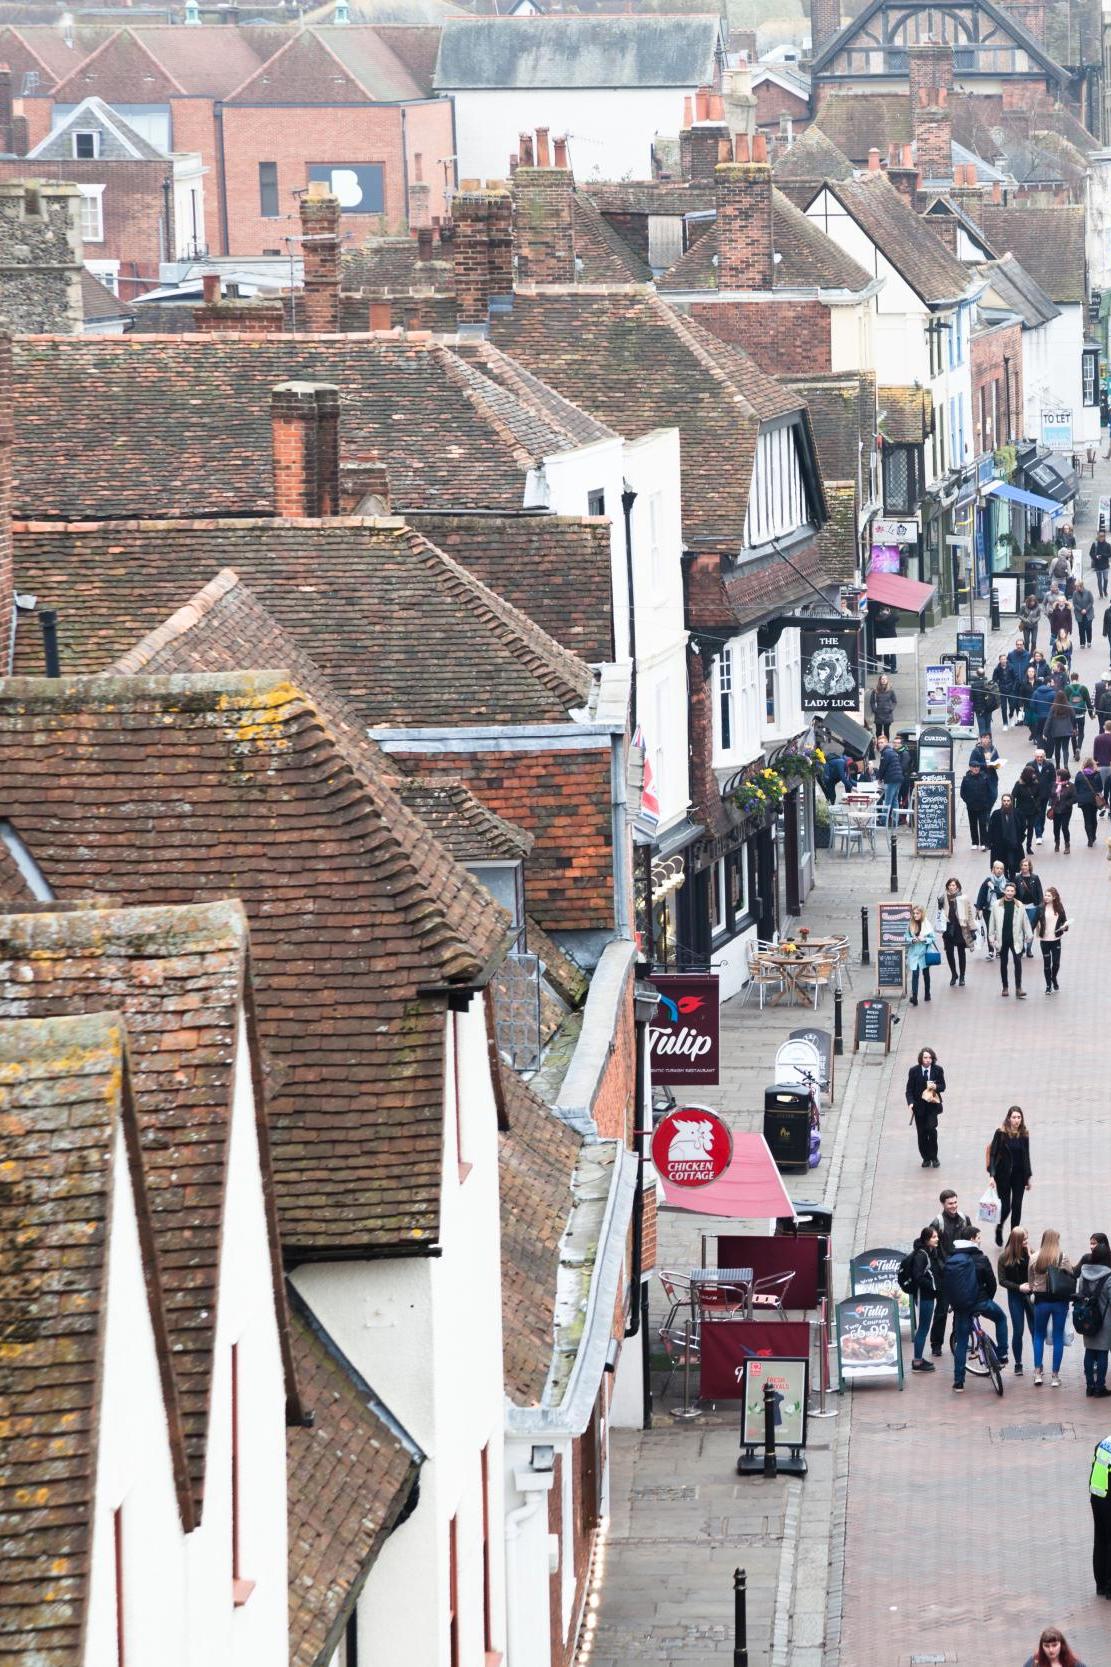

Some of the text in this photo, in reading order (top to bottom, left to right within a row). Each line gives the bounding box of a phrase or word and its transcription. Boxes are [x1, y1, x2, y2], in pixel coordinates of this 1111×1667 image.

[1043, 413, 1071, 424] TO LET
[819, 637, 839, 645] THE
[804, 699, 856, 707] LADY LUCK
[649, 1026, 713, 1062] Tulip
[667, 1161, 714, 1172] CHICKEN
[668, 1171, 715, 1181] COTTAGE
[863, 1305, 889, 1319] Tulip
